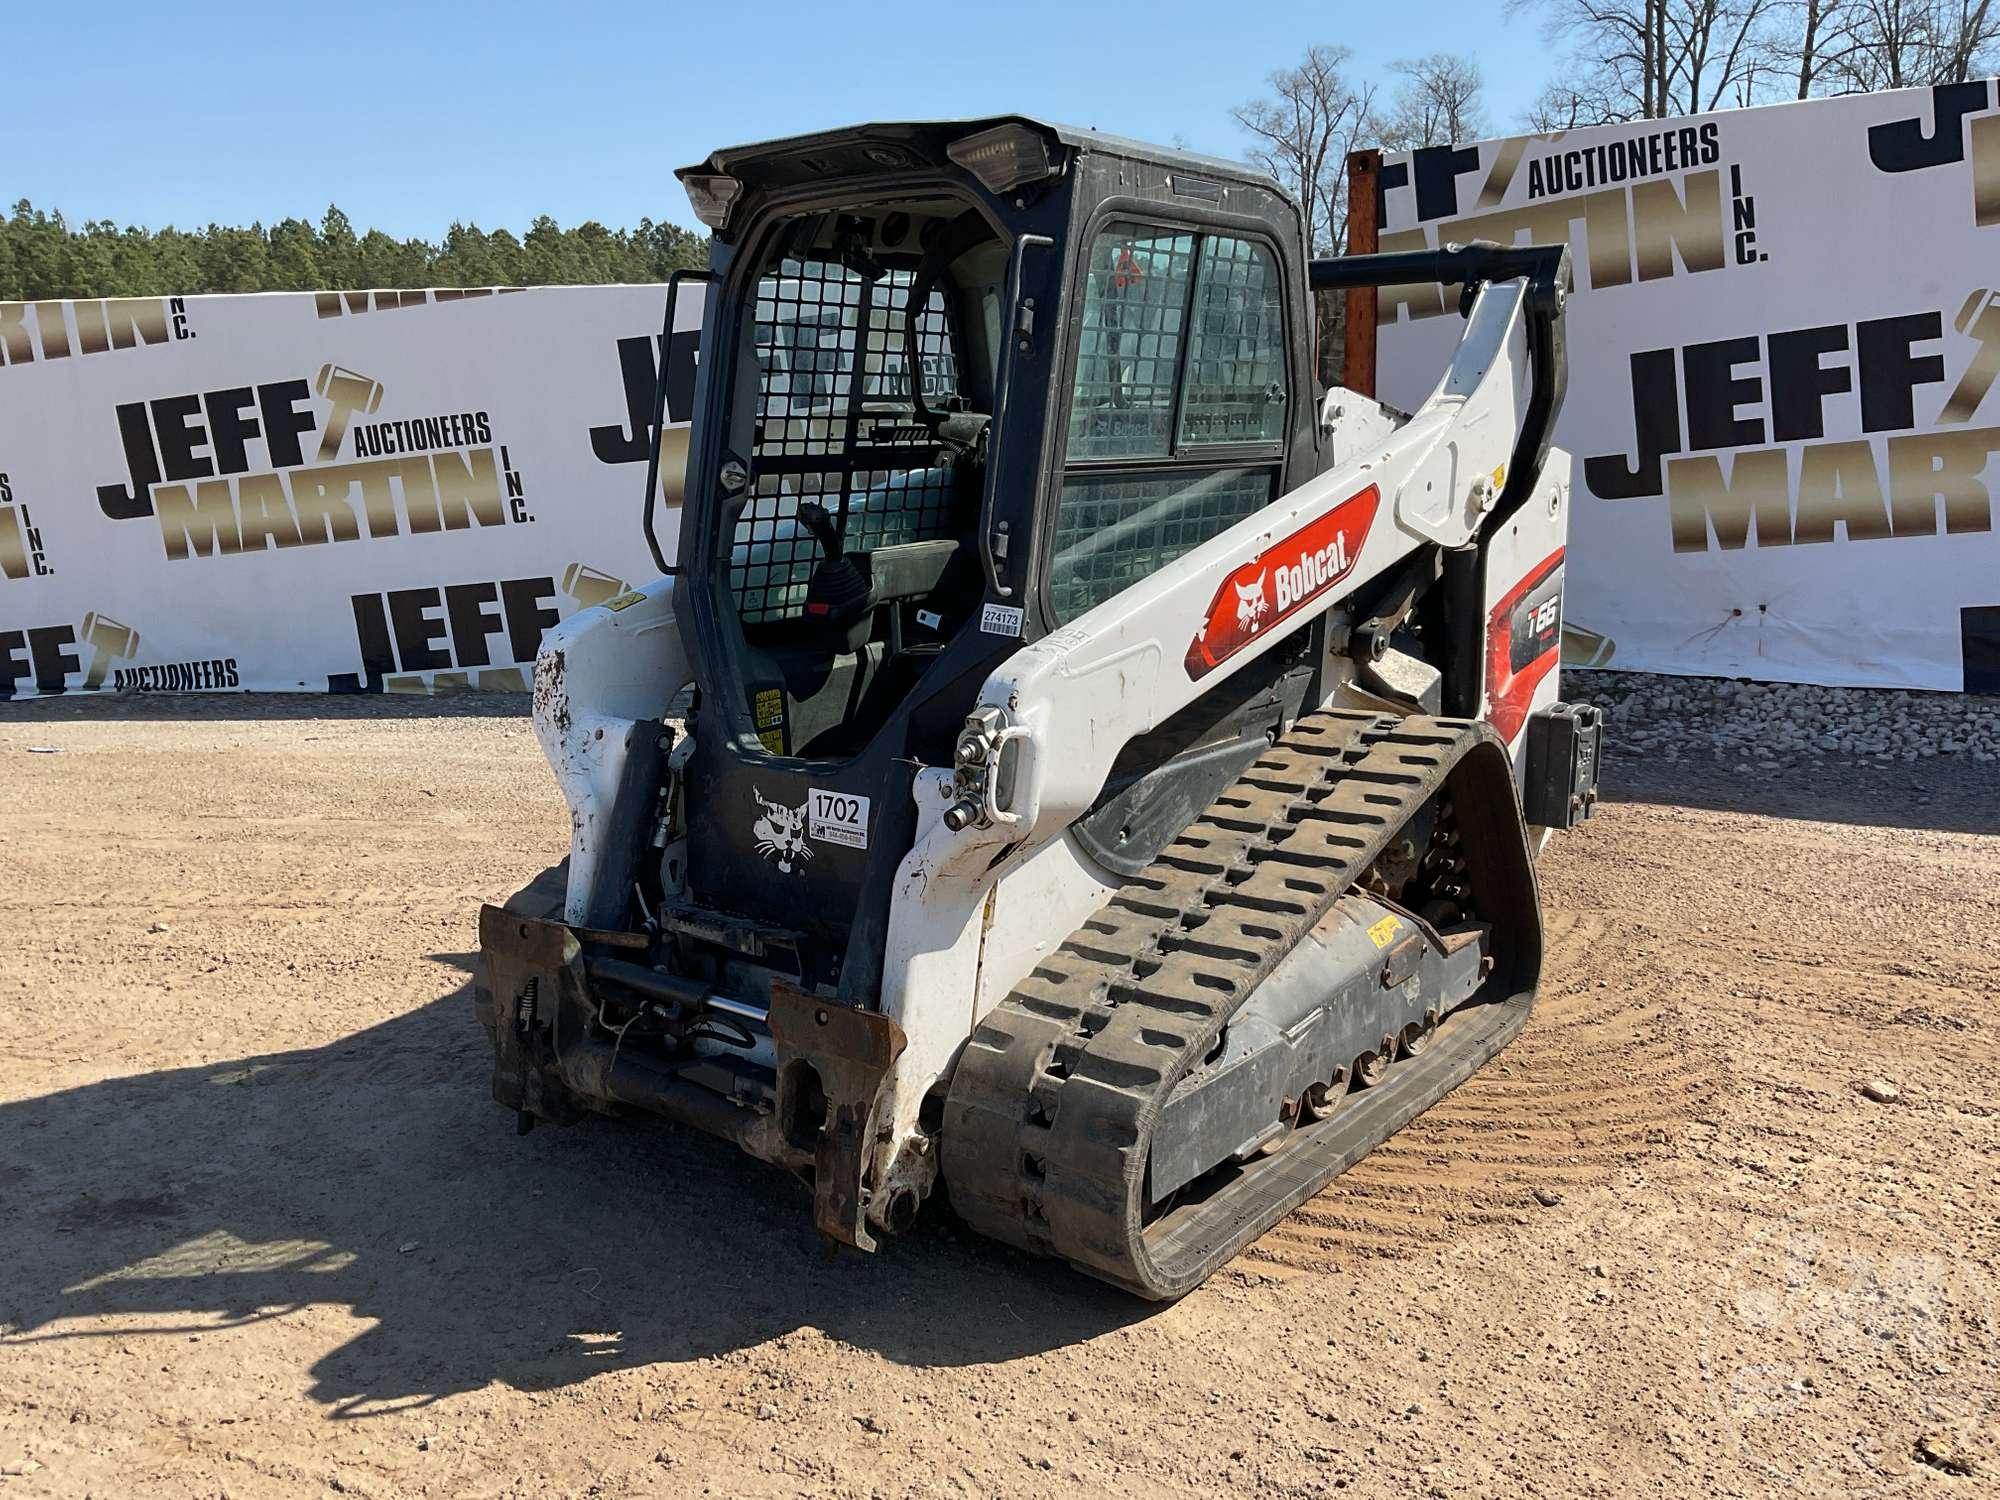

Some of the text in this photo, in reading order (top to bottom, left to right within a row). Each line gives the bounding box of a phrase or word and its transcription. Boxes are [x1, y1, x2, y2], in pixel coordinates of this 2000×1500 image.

[1528, 123, 1720, 199] AUCTIONEERS
[353, 412, 492, 458] AUCTIONEERS
[1584, 311, 1945, 500] JEFF
[96, 379, 317, 520] JEFF
[153, 448, 506, 560] MARTIN
[1275, 530, 1347, 612] Bobcat
[327, 577, 560, 693] JEFF
[984, 610, 1018, 625] 274173
[1527, 595, 1558, 639] T66
[113, 658, 240, 692] AUCTIONEERS
[816, 794, 859, 824] 1702
